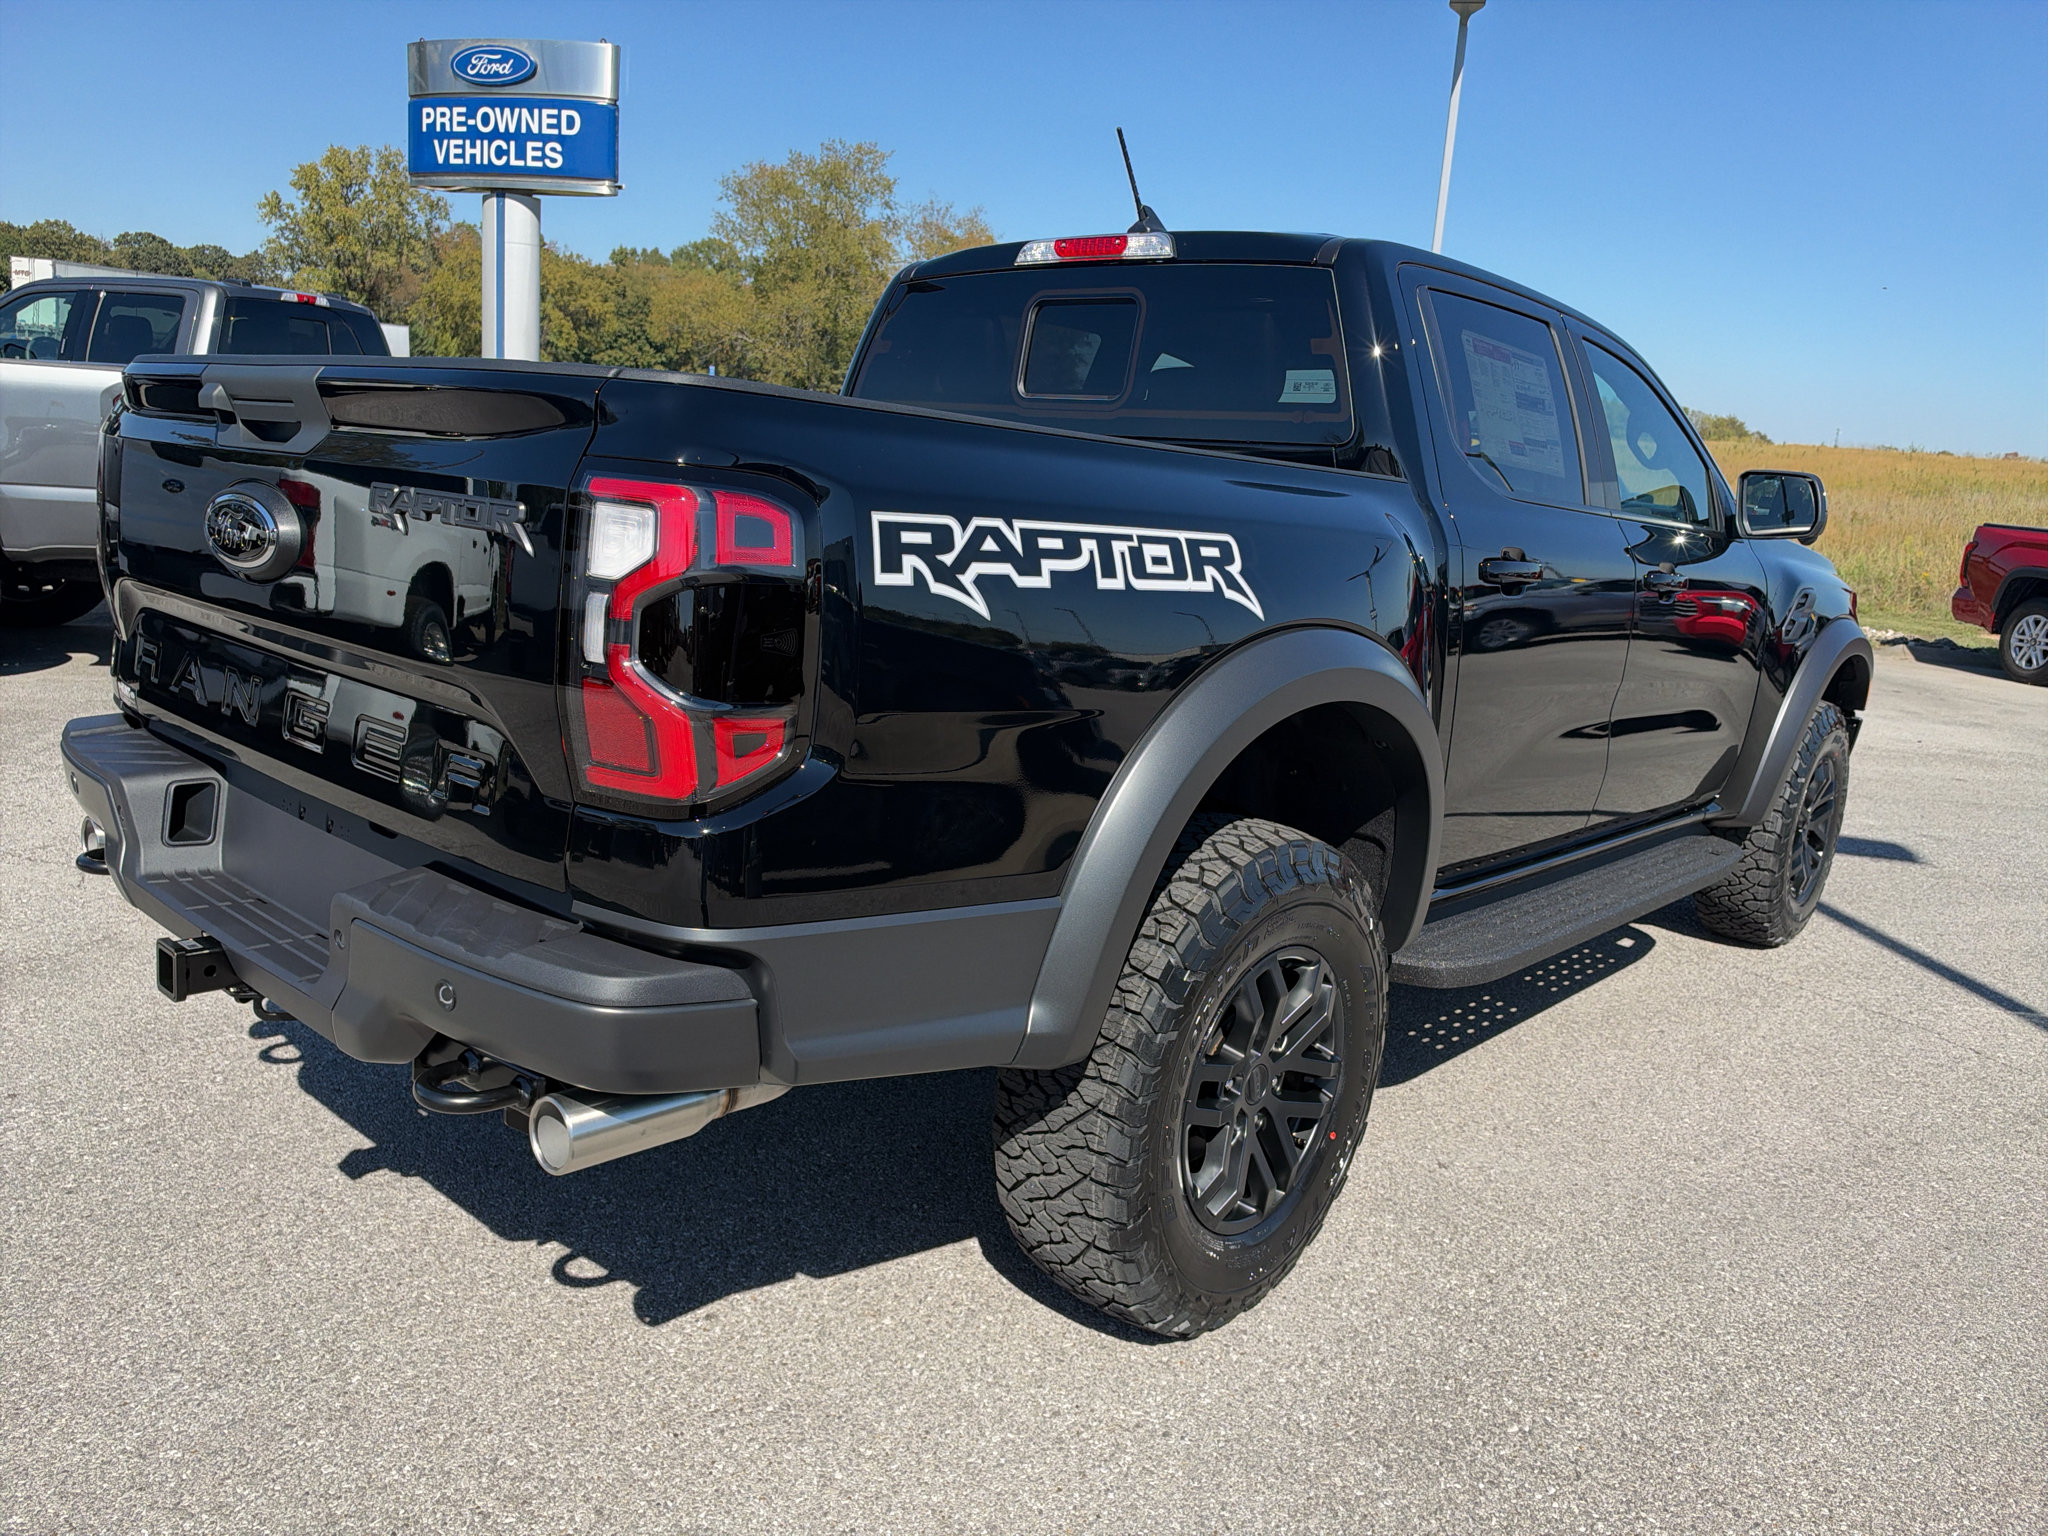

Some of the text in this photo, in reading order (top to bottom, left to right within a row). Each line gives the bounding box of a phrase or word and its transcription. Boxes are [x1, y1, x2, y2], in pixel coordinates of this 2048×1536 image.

[467, 53, 514, 75] Ford
[422, 107, 581, 135] PRE-OWNED
[434, 139, 563, 168] VEHICLES
[209, 508, 252, 552] Ford
[369, 481, 535, 557] RAPTOR
[870, 511, 1265, 621] RAPTOR
[134, 632, 497, 816] RANGER
